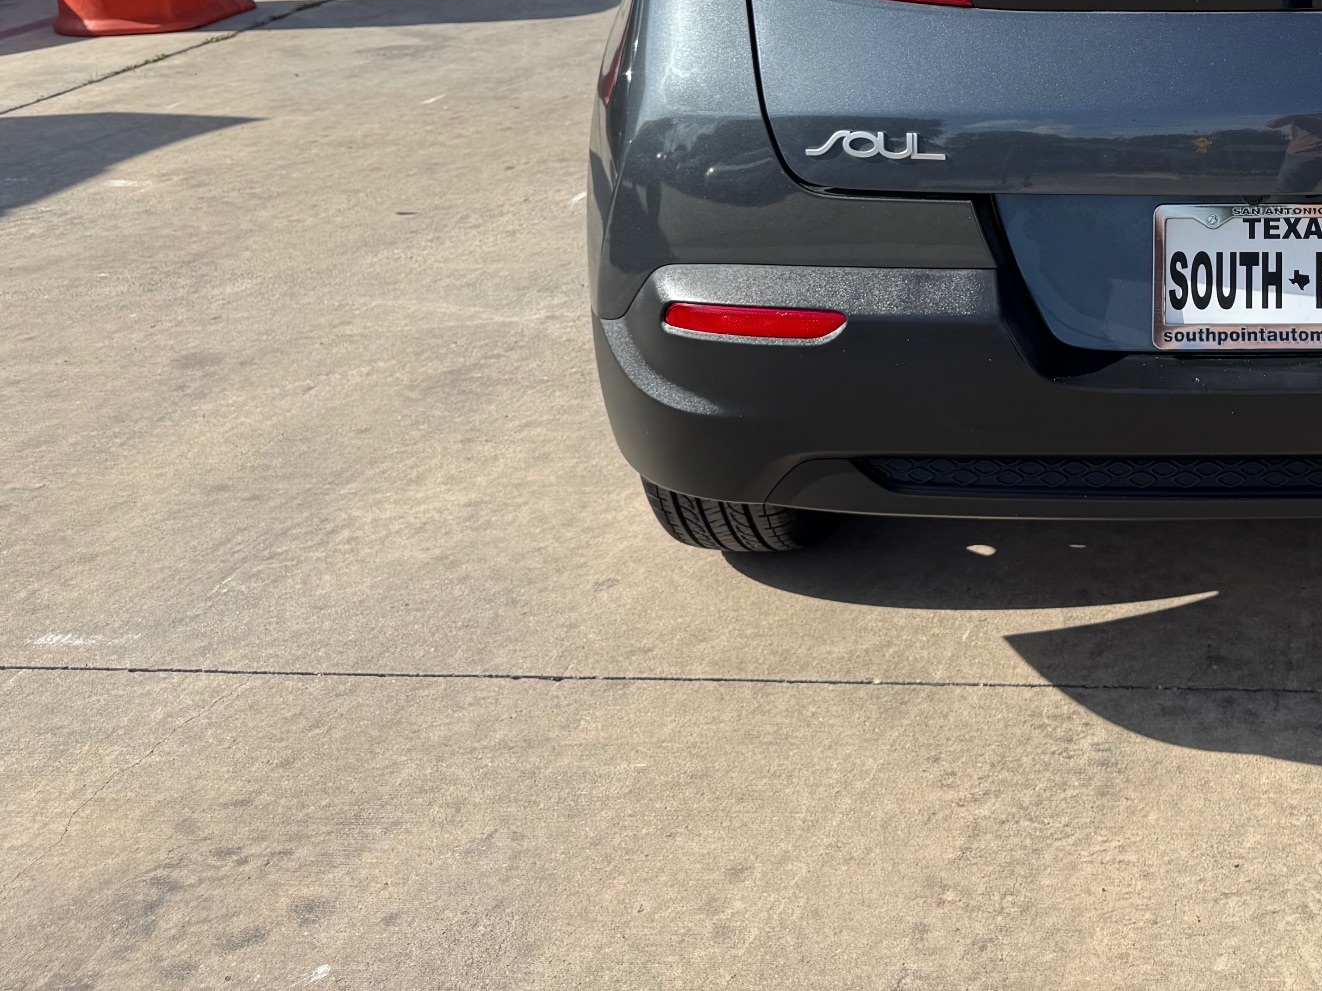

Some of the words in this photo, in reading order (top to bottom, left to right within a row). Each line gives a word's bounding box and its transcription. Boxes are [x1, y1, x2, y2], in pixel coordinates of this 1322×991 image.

[805, 130, 946, 160] SOUL
[1232, 207, 1261, 216] SAN
[1168, 250, 1283, 310] SOUTH
